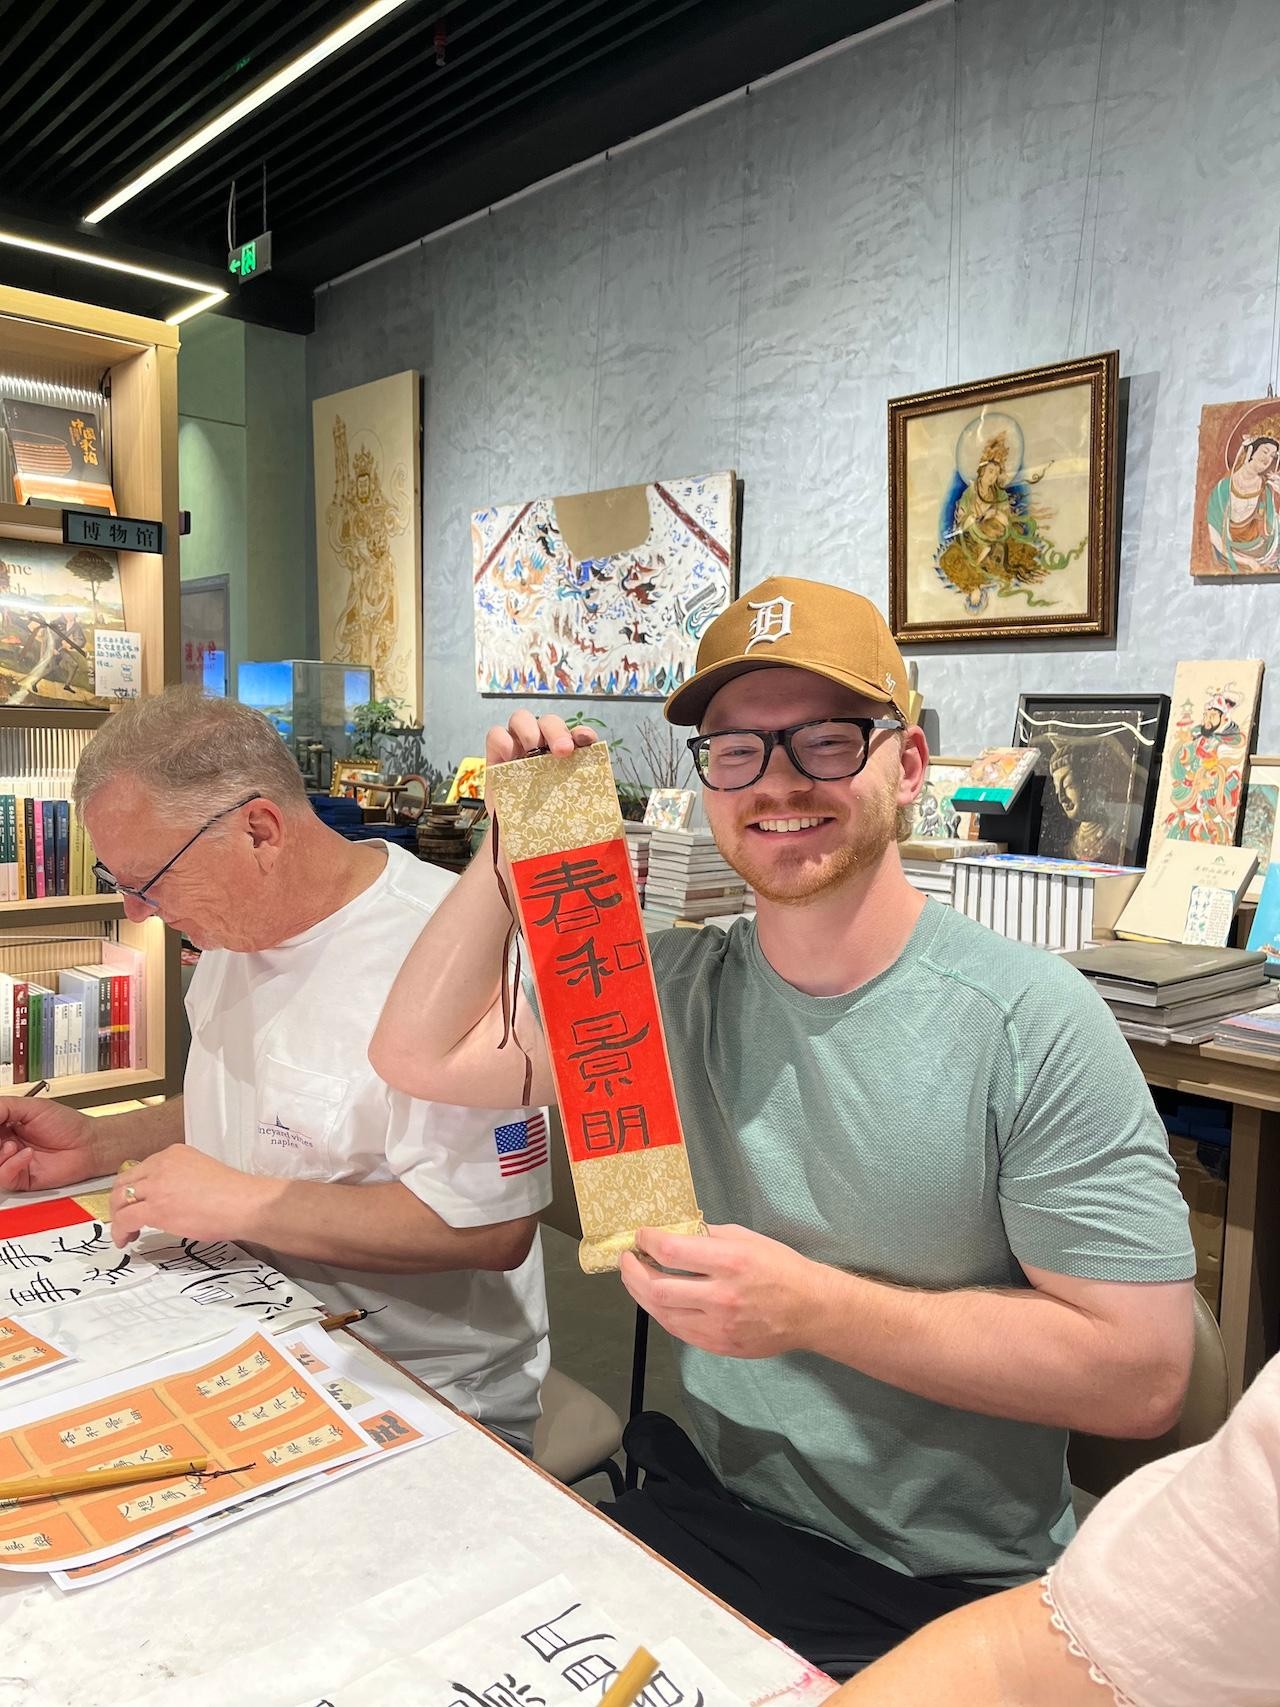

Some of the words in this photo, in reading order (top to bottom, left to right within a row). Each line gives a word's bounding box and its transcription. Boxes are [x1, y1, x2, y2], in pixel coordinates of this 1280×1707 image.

[82, 519, 155, 548] 博物馆
[744, 595, 796, 656] D
[521, 858, 650, 1154] 春和景明
[270, 1138, 298, 1148] naples
[60, 1407, 143, 1447] 春和景明
